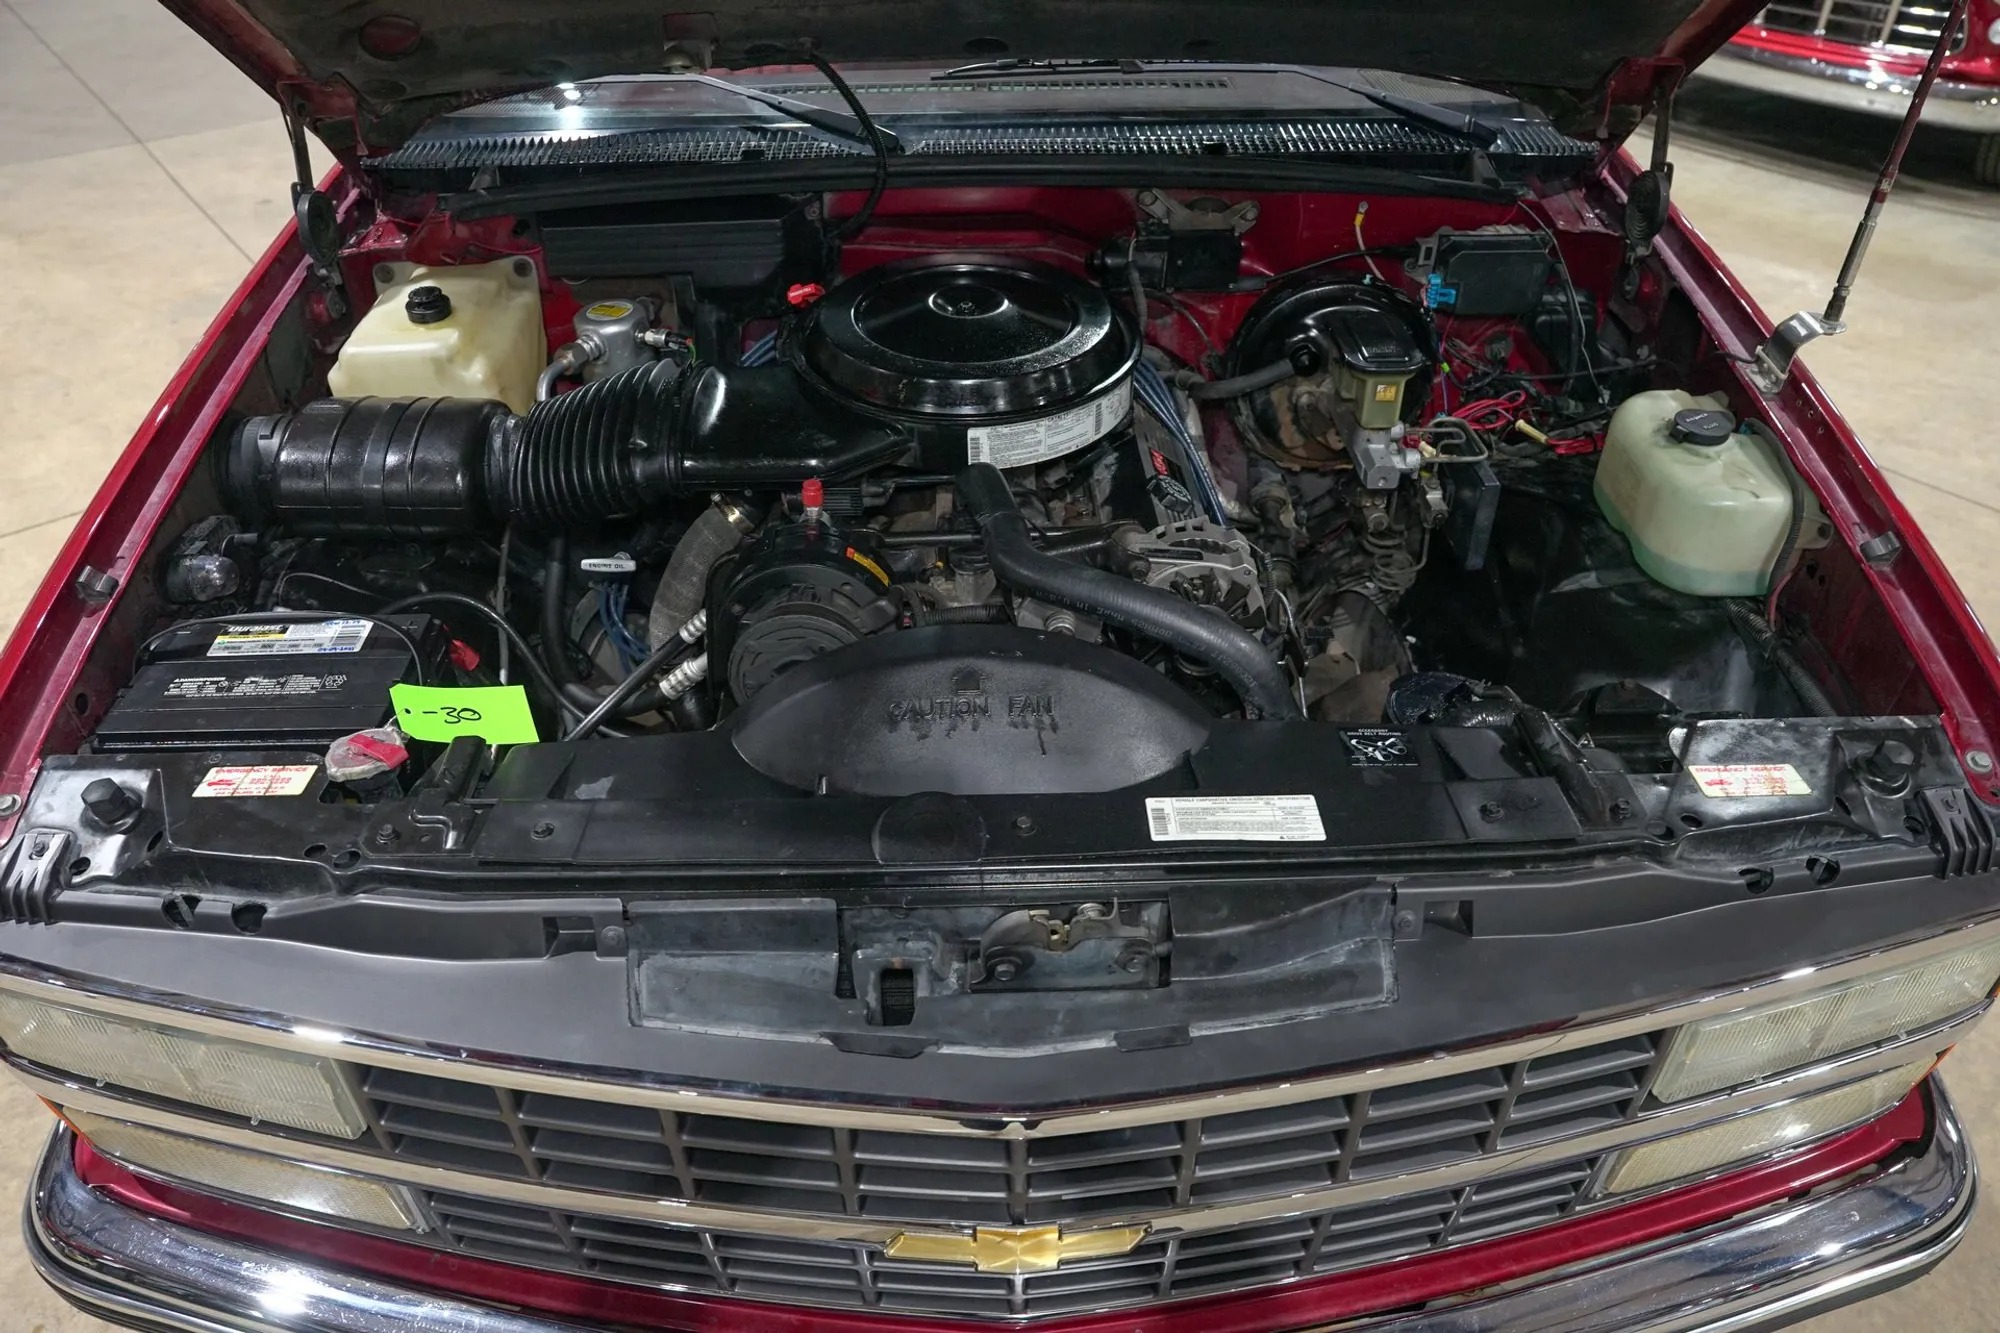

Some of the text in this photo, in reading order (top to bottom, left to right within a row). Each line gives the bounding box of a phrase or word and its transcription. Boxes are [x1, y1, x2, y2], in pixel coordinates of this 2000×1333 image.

[422, 706, 482, 724] -30
[888, 695, 1054, 720] CAUTION FAN
